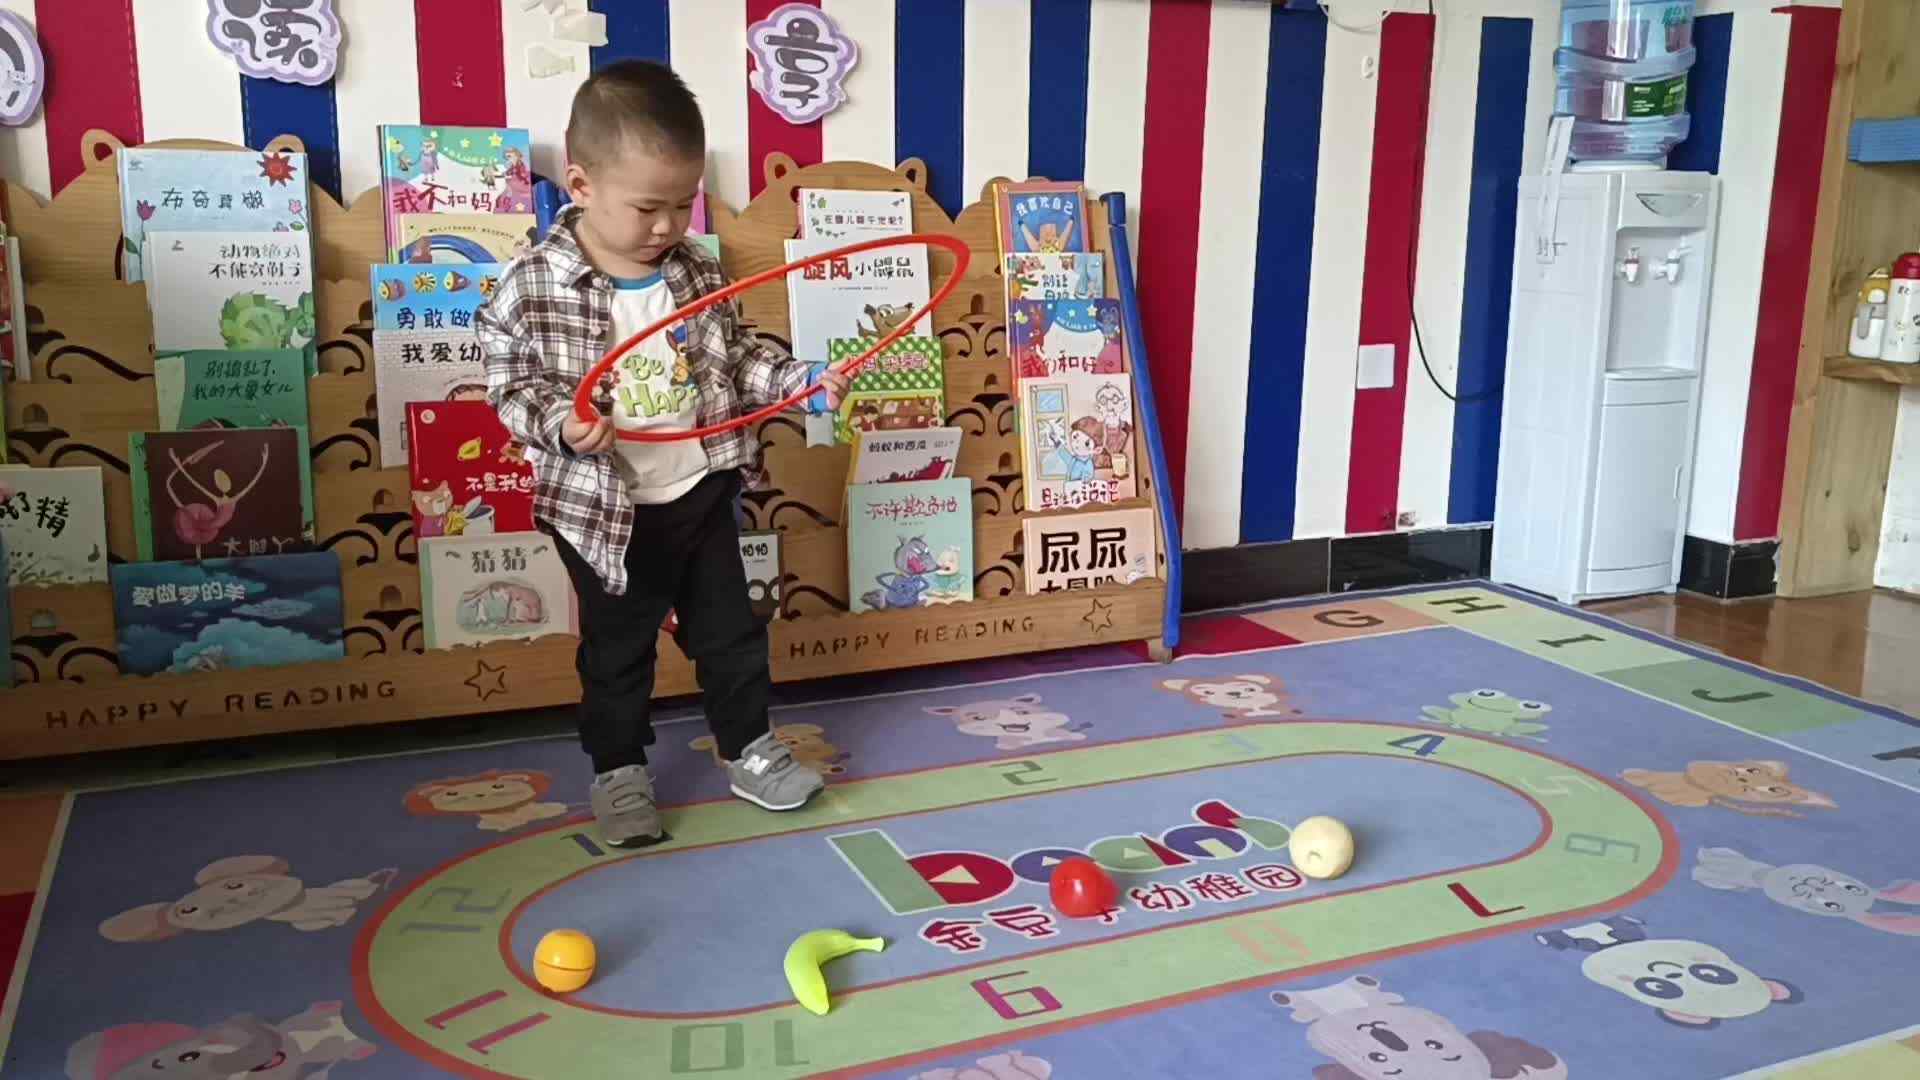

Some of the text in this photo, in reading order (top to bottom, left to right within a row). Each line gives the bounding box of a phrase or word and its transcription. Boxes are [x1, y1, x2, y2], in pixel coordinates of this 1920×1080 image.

[397, 307, 472, 330] 勇敢做
[1037, 527, 1128, 575] 尿尿
[789, 617, 1036, 658] HAPPY READING
[1313, 609, 1383, 629] G
[46, 681, 396, 729] HAPPY READING
